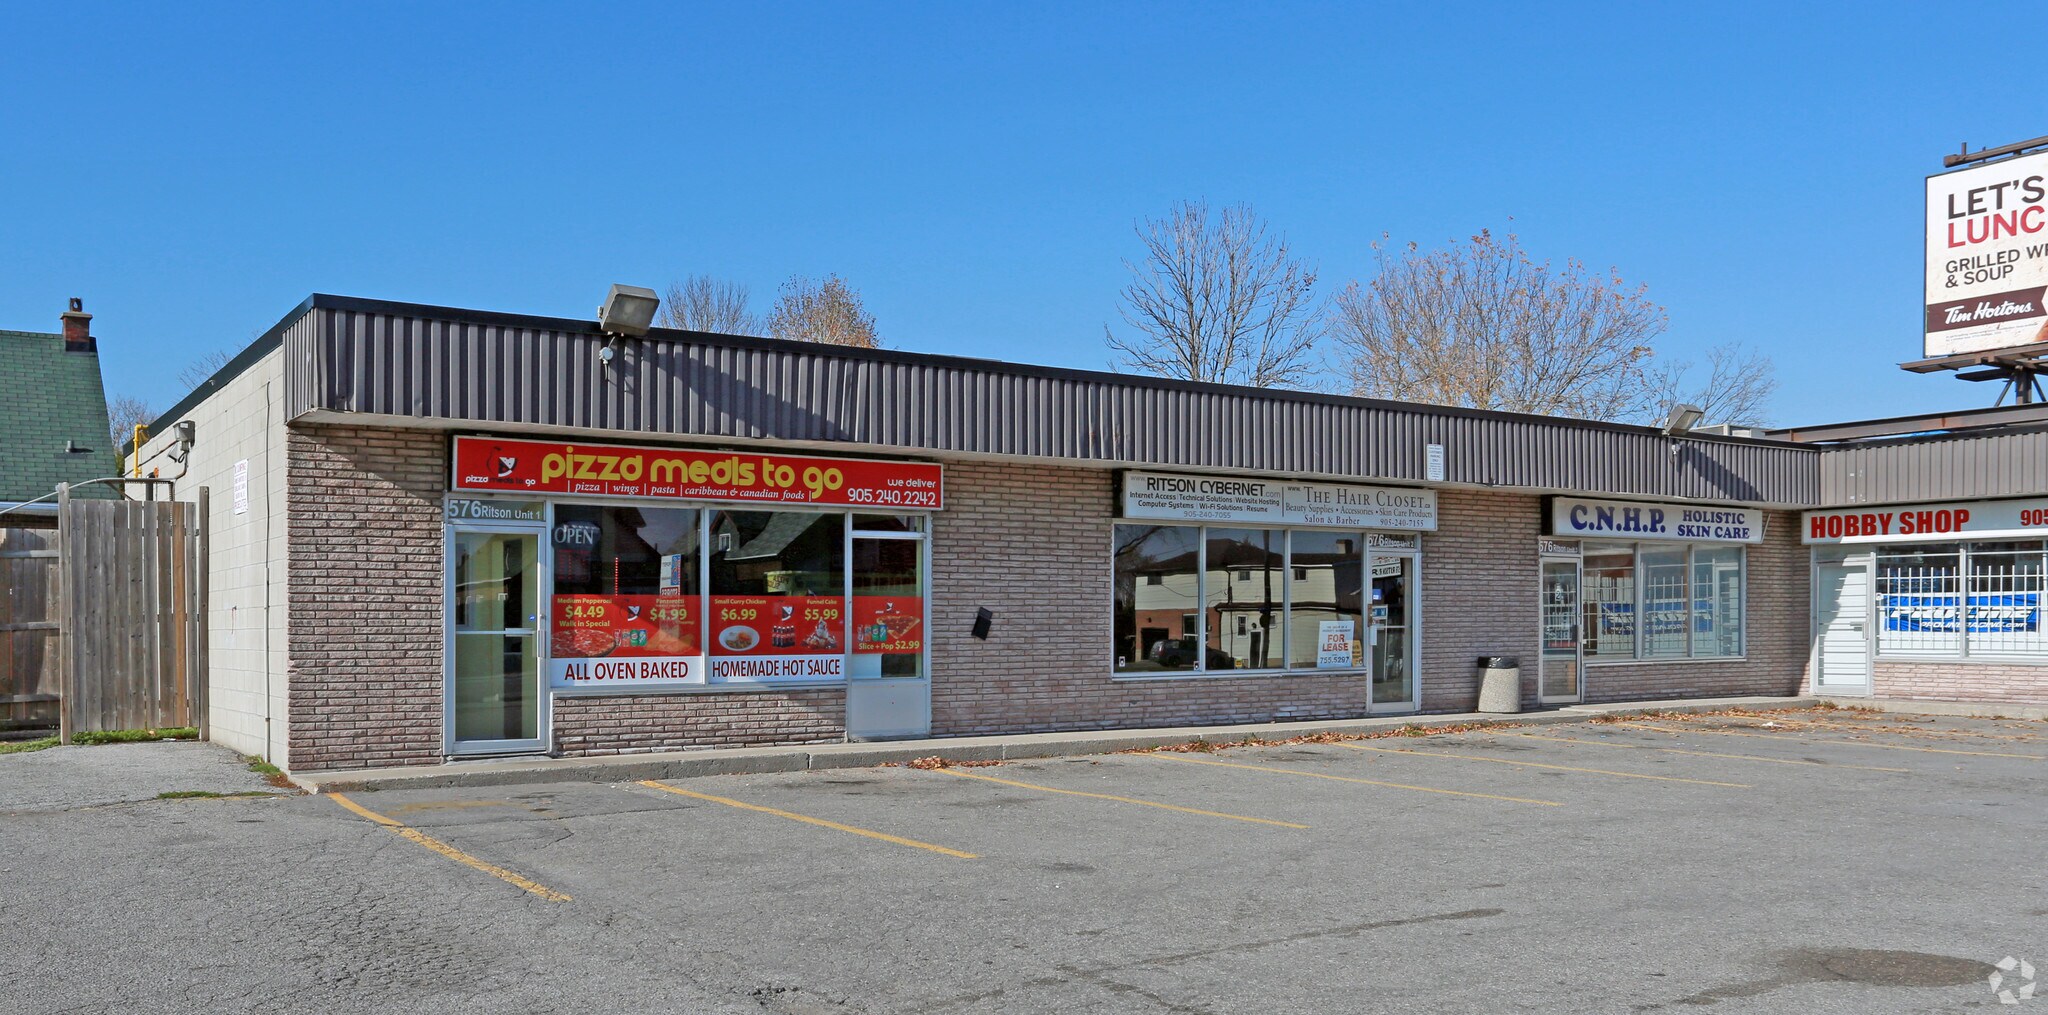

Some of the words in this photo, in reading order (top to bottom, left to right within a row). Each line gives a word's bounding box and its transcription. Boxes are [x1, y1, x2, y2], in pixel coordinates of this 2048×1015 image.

[1948, 175, 2045, 220] LET'S
[1946, 249, 2020, 273] GRILLED
[1946, 274, 1958, 288] &
[1964, 265, 2014, 285] SOUP
[1945, 306, 1972, 325] Tim
[525, 479, 536, 487] go
[762, 458, 795, 487] to
[803, 466, 843, 499] go
[888, 479, 904, 487] we
[906, 478, 936, 488] deliver
[1147, 477, 1195, 493] RITSON
[575, 482, 600, 493] pizza
[613, 484, 639, 495] wings
[650, 485, 675, 496] pasta
[684, 485, 728, 496] caribbean
[729, 488, 738, 496] &
[740, 488, 779, 499] canadian
[781, 490, 805, 501] foods
[848, 488, 936, 506] 905.240.2242
[1129, 491, 1153, 499] Internet
[1155, 492, 1176, 500] Access
[1179, 493, 1204, 501] Technical
[1206, 495, 1232, 503] Solutions
[1259, 498, 1280, 507] Hosting
[1304, 486, 1331, 504] THE
[1336, 488, 1371, 506] HAIR
[449, 500, 482, 518] 576
[481, 505, 511, 519] Ritson
[514, 509, 536, 520] Unit
[1138, 500, 1167, 509] Computer
[1168, 501, 1194, 509] Systems
[1199, 502, 1215, 510] Wi-Fi
[1217, 503, 1243, 511] Solutions
[1286, 502, 1306, 514] Beauty
[1309, 504, 1333, 515] Supplies
[1341, 505, 1373, 515] Accessories
[1380, 508, 1392, 516] Skin
[1394, 508, 1407, 517] Care
[1409, 509, 1432, 518] Products
[1305, 514, 1325, 523] Salon
[1336, 516, 1360, 525] Barber
[1570, 504, 1666, 533] C.N.H.P.
[1683, 510, 1745, 525] HOLISTIC
[1811, 512, 1893, 538] HOBBY
[1900, 509, 1969, 535] SHOP
[554, 527, 594, 544] OPEN
[1678, 525, 1712, 537] SKIN
[1715, 525, 1750, 539] CARE
[1539, 541, 1553, 552] 576
[730, 598, 745, 606] Curry
[565, 606, 605, 619] $4.49
[650, 608, 687, 621] $4.99
[721, 608, 757, 621] $6.99
[804, 608, 839, 621] $5.99
[586, 620, 610, 628] Special
[858, 642, 874, 650] Slice
[881, 642, 893, 651] Pop
[895, 640, 920, 650] $2.99
[1328, 634, 1345, 642] FOR
[1322, 643, 1349, 652] LEASE
[564, 663, 590, 681] ALL
[594, 662, 636, 680] OVEN
[641, 661, 688, 679] BAKED
[712, 660, 779, 677] HOMEMADE
[782, 659, 804, 676] HOT
[807, 659, 840, 675] SAUCE
